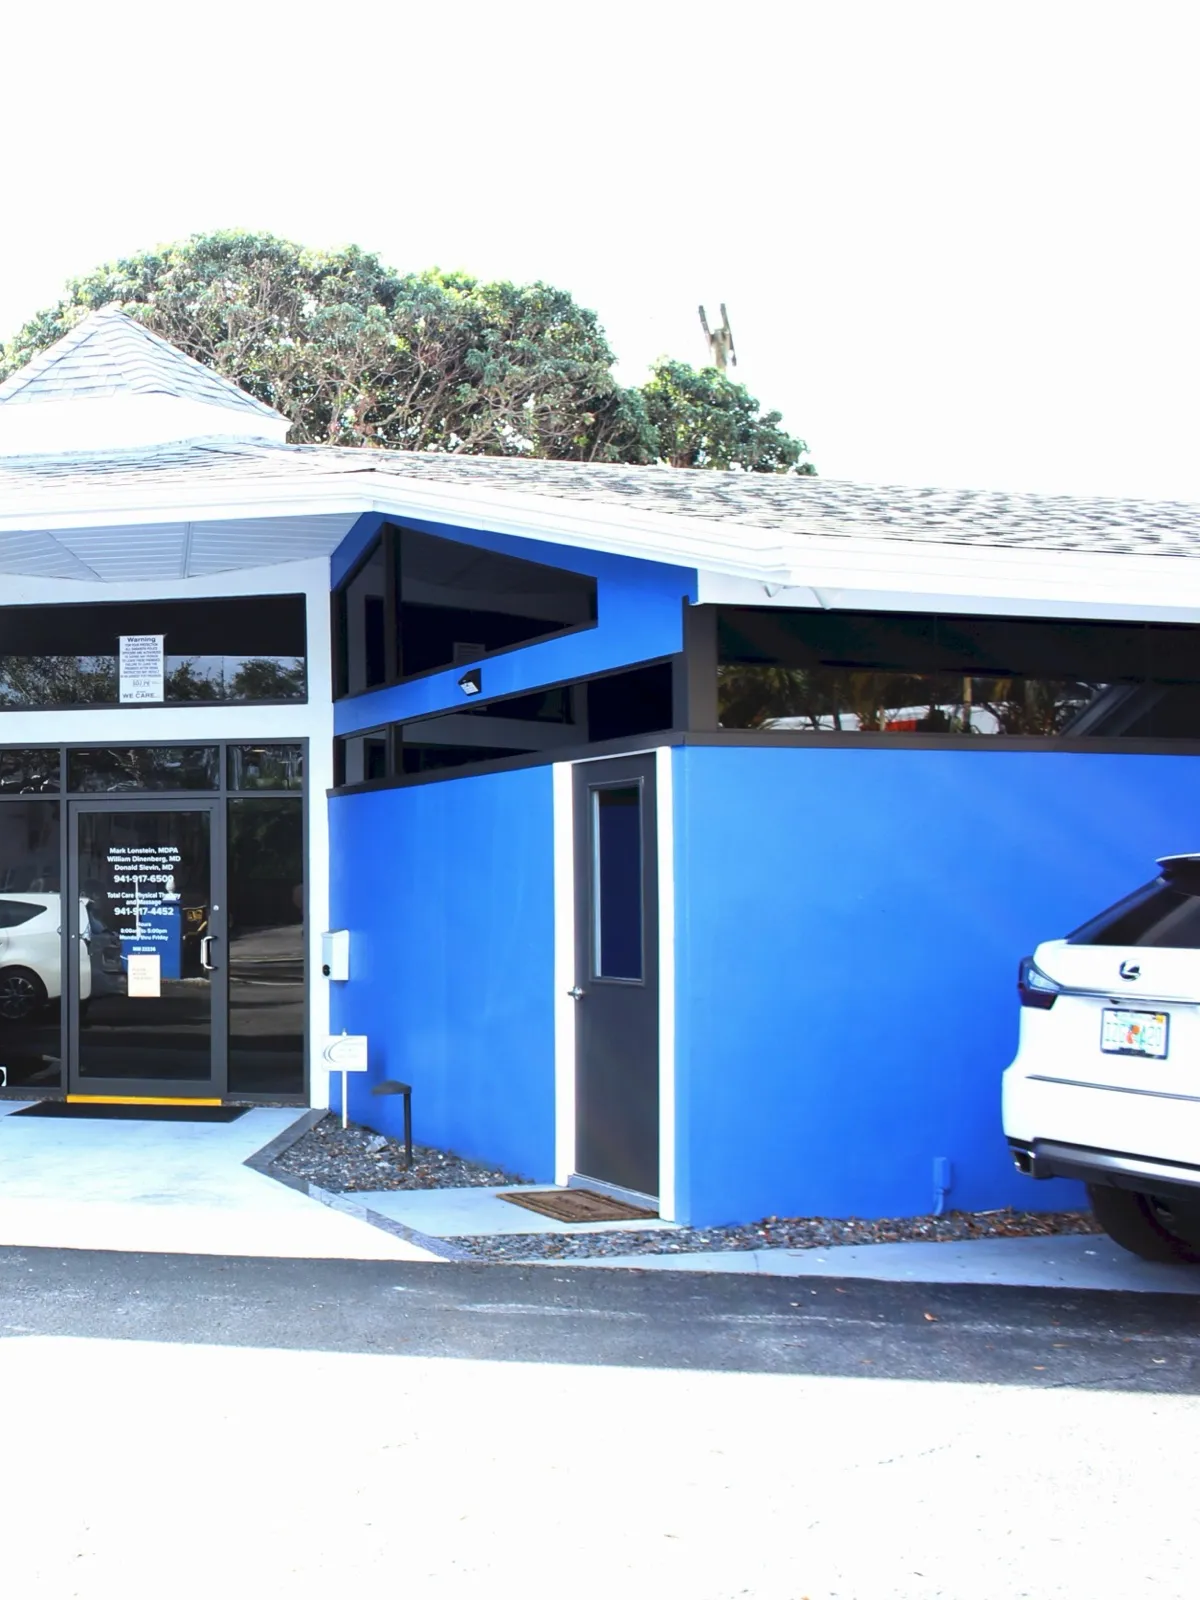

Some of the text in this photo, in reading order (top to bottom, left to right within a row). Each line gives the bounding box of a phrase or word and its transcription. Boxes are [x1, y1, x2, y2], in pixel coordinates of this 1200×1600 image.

[113, 874, 175, 883] 941-917-6500
[158, 892, 181, 900] Thpy
[114, 907, 174, 916] 941-917-4452
